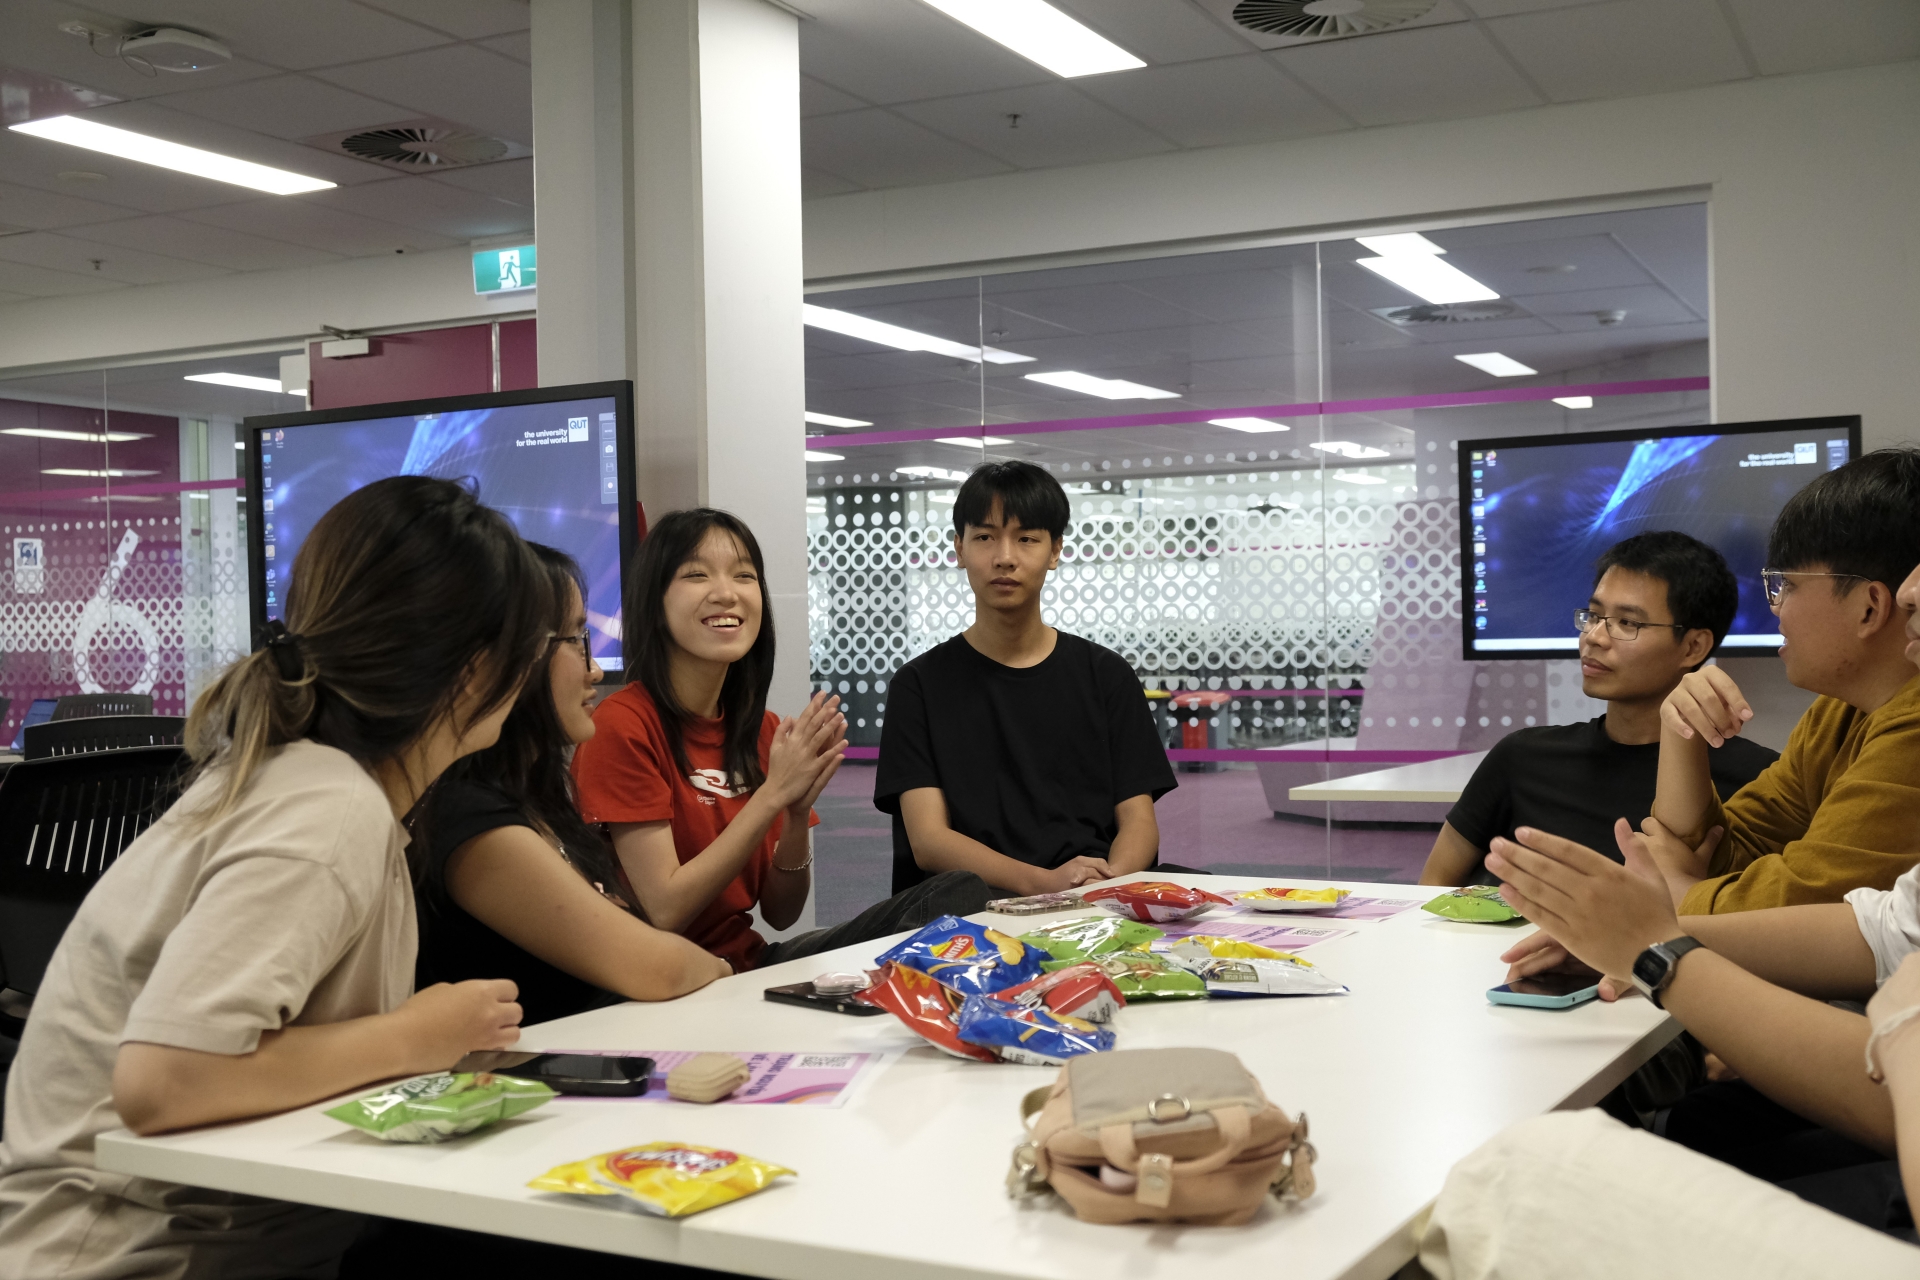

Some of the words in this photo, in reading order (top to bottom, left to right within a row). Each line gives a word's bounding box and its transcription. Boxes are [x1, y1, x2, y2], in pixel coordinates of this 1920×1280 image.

[569, 419, 587, 430] QUT
[524, 431, 535, 439] the
[536, 428, 568, 438] university
[516, 439, 525, 447] for
[526, 438, 536, 446] the
[537, 437, 550, 445] real
[550, 436, 568, 444] world
[942, 936, 970, 960] MITH'S
